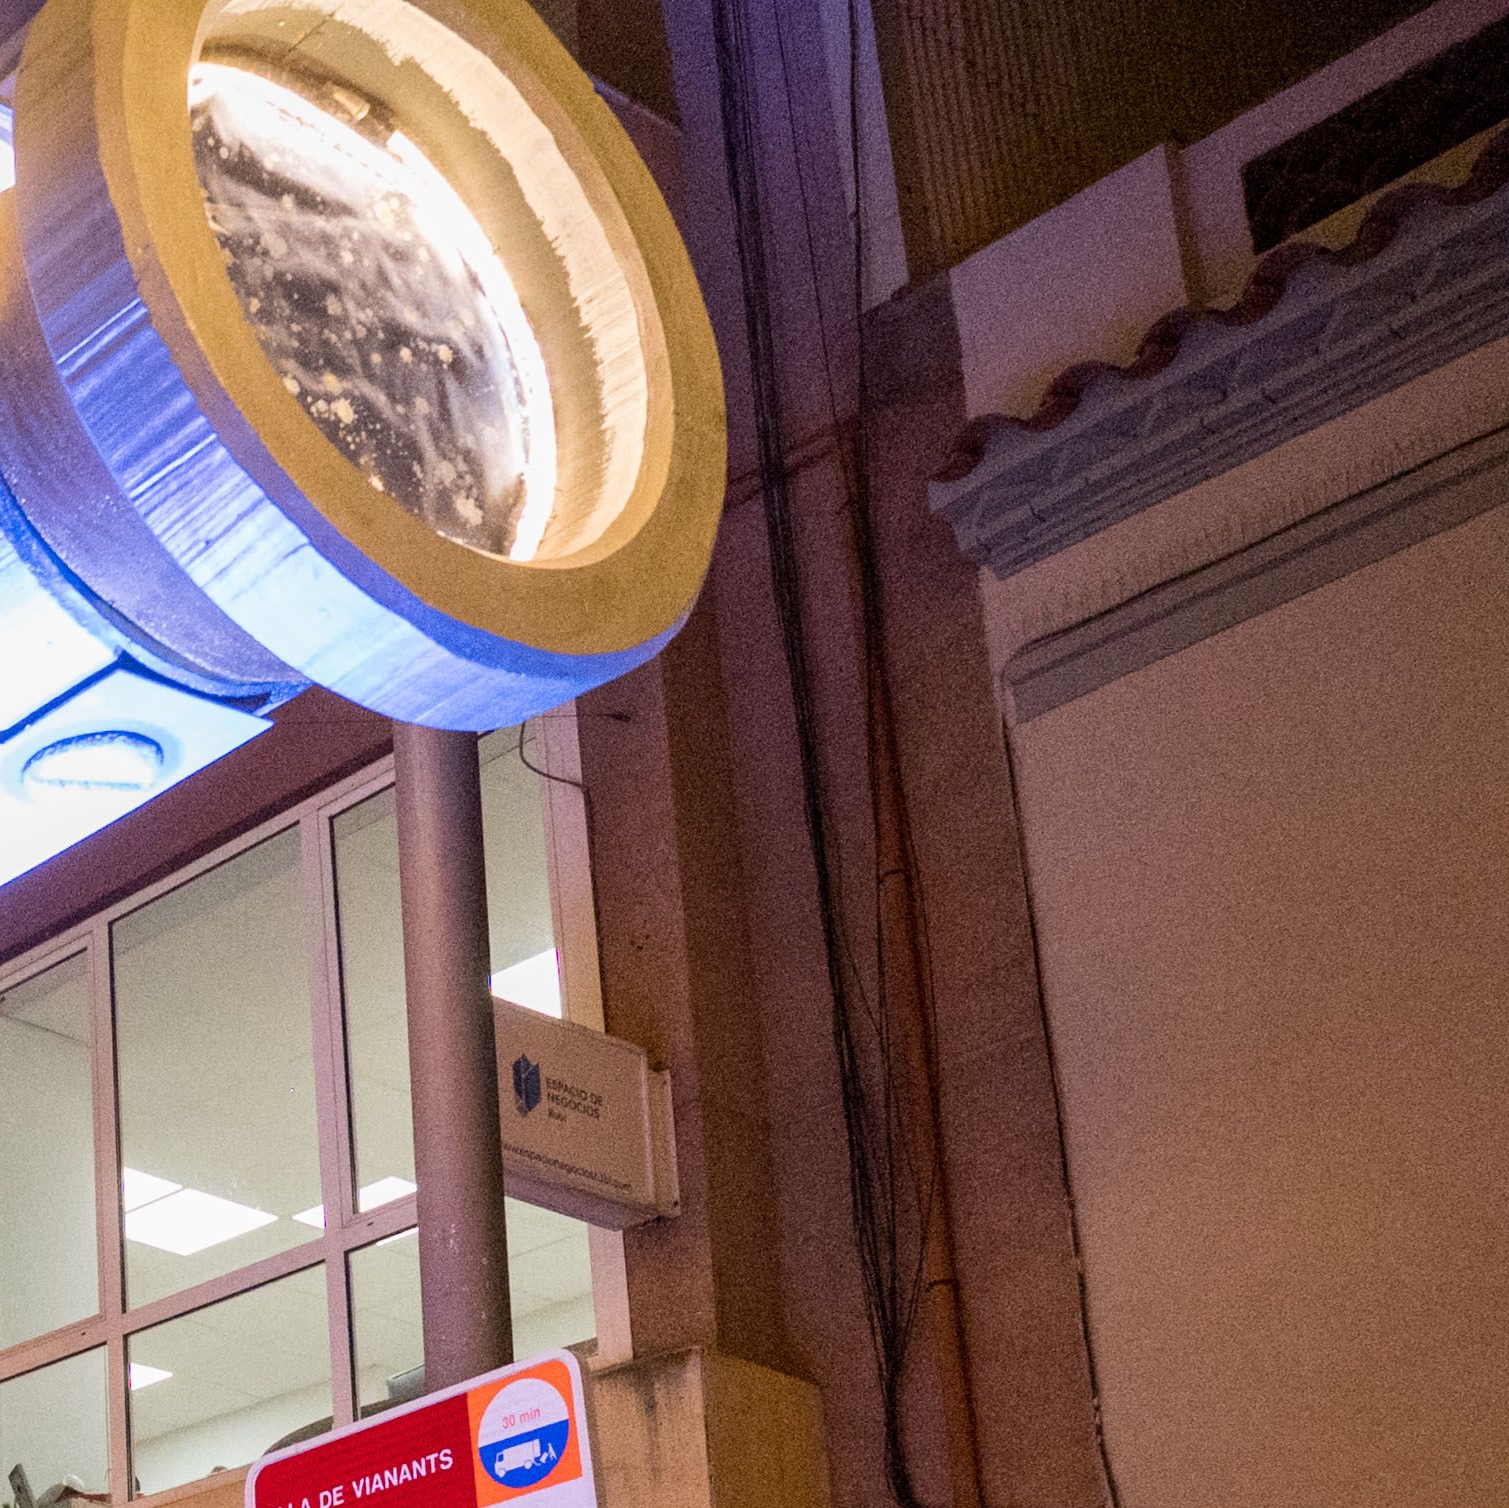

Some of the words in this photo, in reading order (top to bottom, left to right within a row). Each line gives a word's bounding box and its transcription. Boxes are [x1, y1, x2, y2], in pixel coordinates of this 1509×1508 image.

[547, 1092, 600, 1119] NEGOCIOS
[590, 1092, 603, 1106] DE
[502, 1414, 516, 1430] 30
[519, 1408, 541, 1427] min
[352, 1448, 454, 1499] VIANANTS
